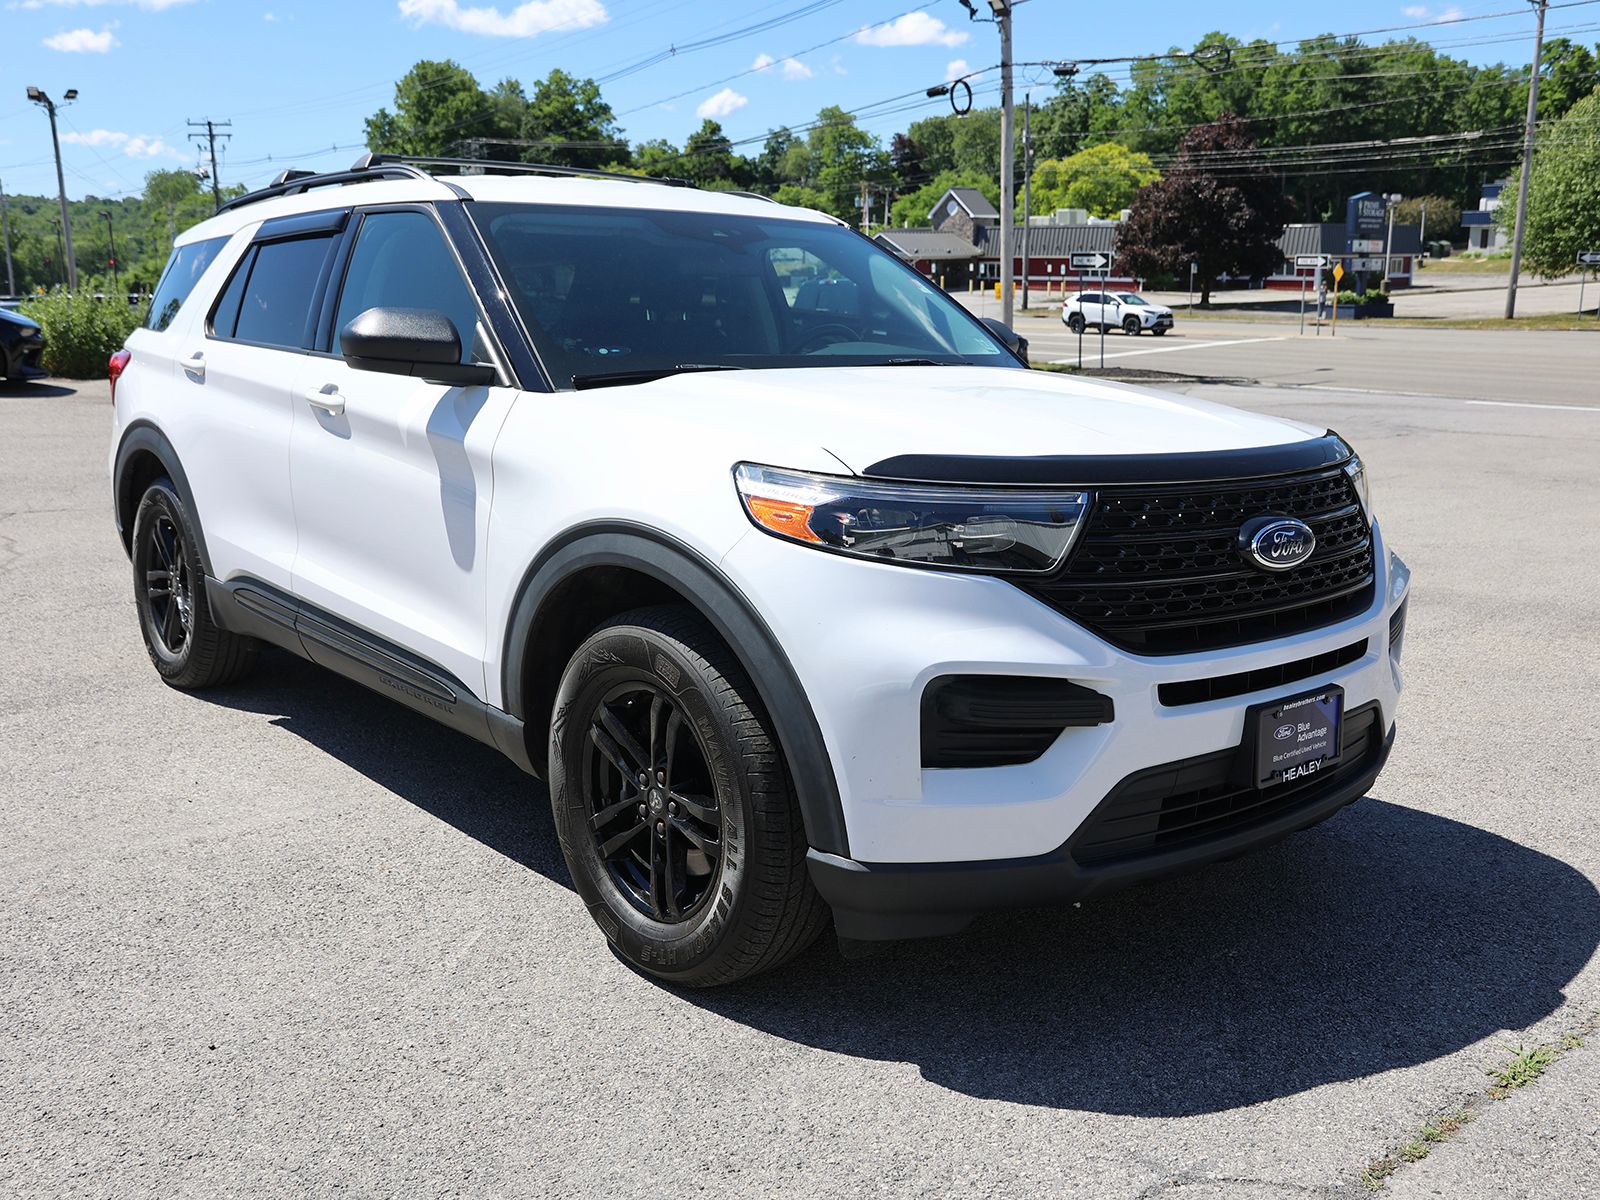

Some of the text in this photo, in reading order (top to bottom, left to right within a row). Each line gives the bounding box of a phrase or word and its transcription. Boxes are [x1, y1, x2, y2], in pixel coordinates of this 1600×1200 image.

[1271, 531, 1304, 558] Ford
[378, 676, 455, 714] EXPLORER
[1283, 694, 1326, 711] healeybrothers.com
[1277, 727, 1292, 738] Ford
[1296, 727, 1328, 743] Advantage
[1297, 722, 1311, 733] Blue
[1283, 747, 1301, 760] Certified
[1282, 759, 1322, 783] HEALEY
[725, 815, 738, 871] ALL
